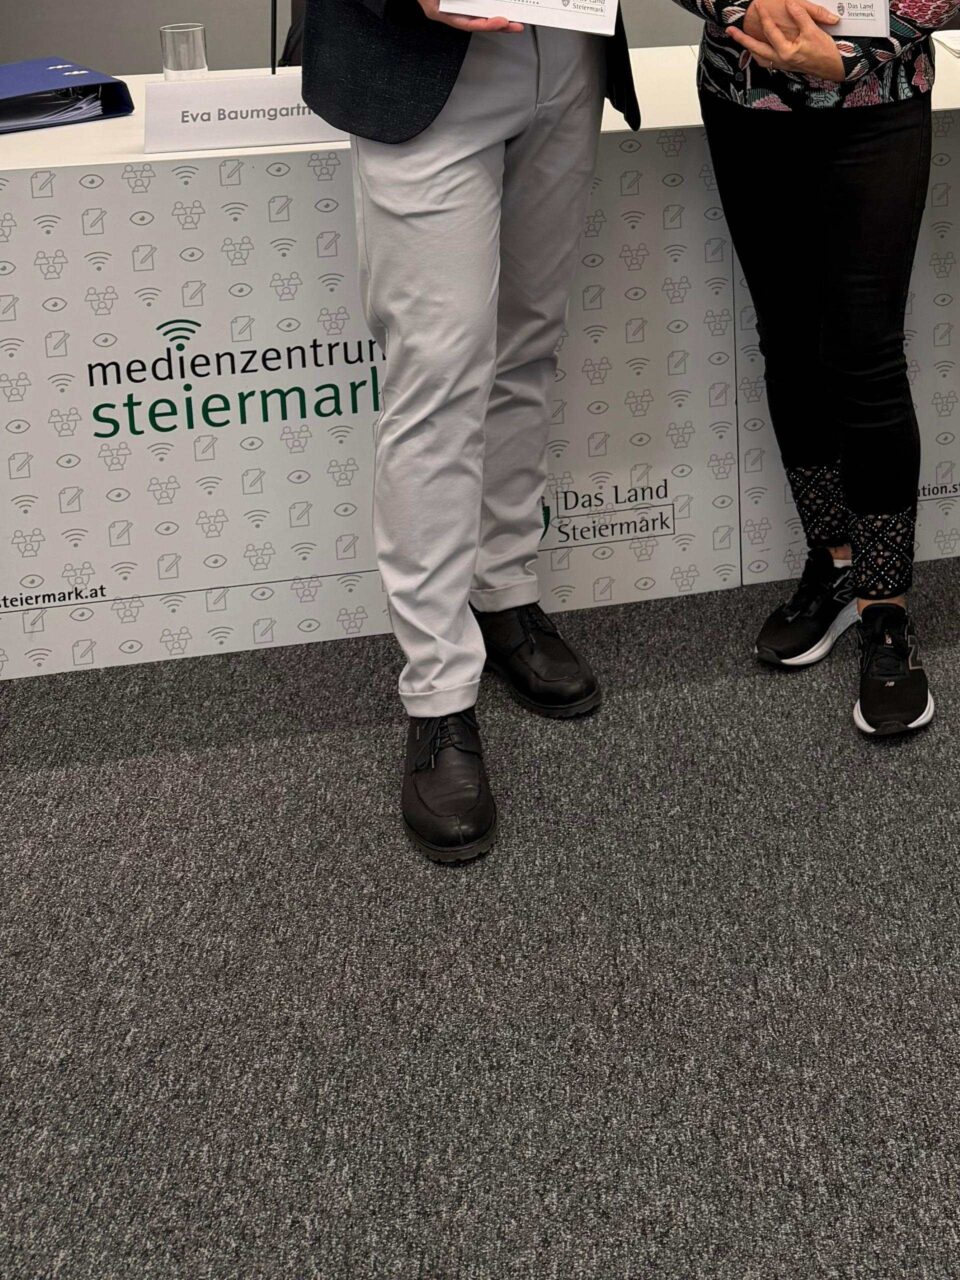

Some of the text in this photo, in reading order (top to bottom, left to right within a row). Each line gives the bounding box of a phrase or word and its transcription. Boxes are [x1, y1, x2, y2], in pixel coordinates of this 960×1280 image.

[180, 110, 212, 124] Eva
[562, 480, 669, 511] Das Land
[557, 513, 671, 543] Steiermark
